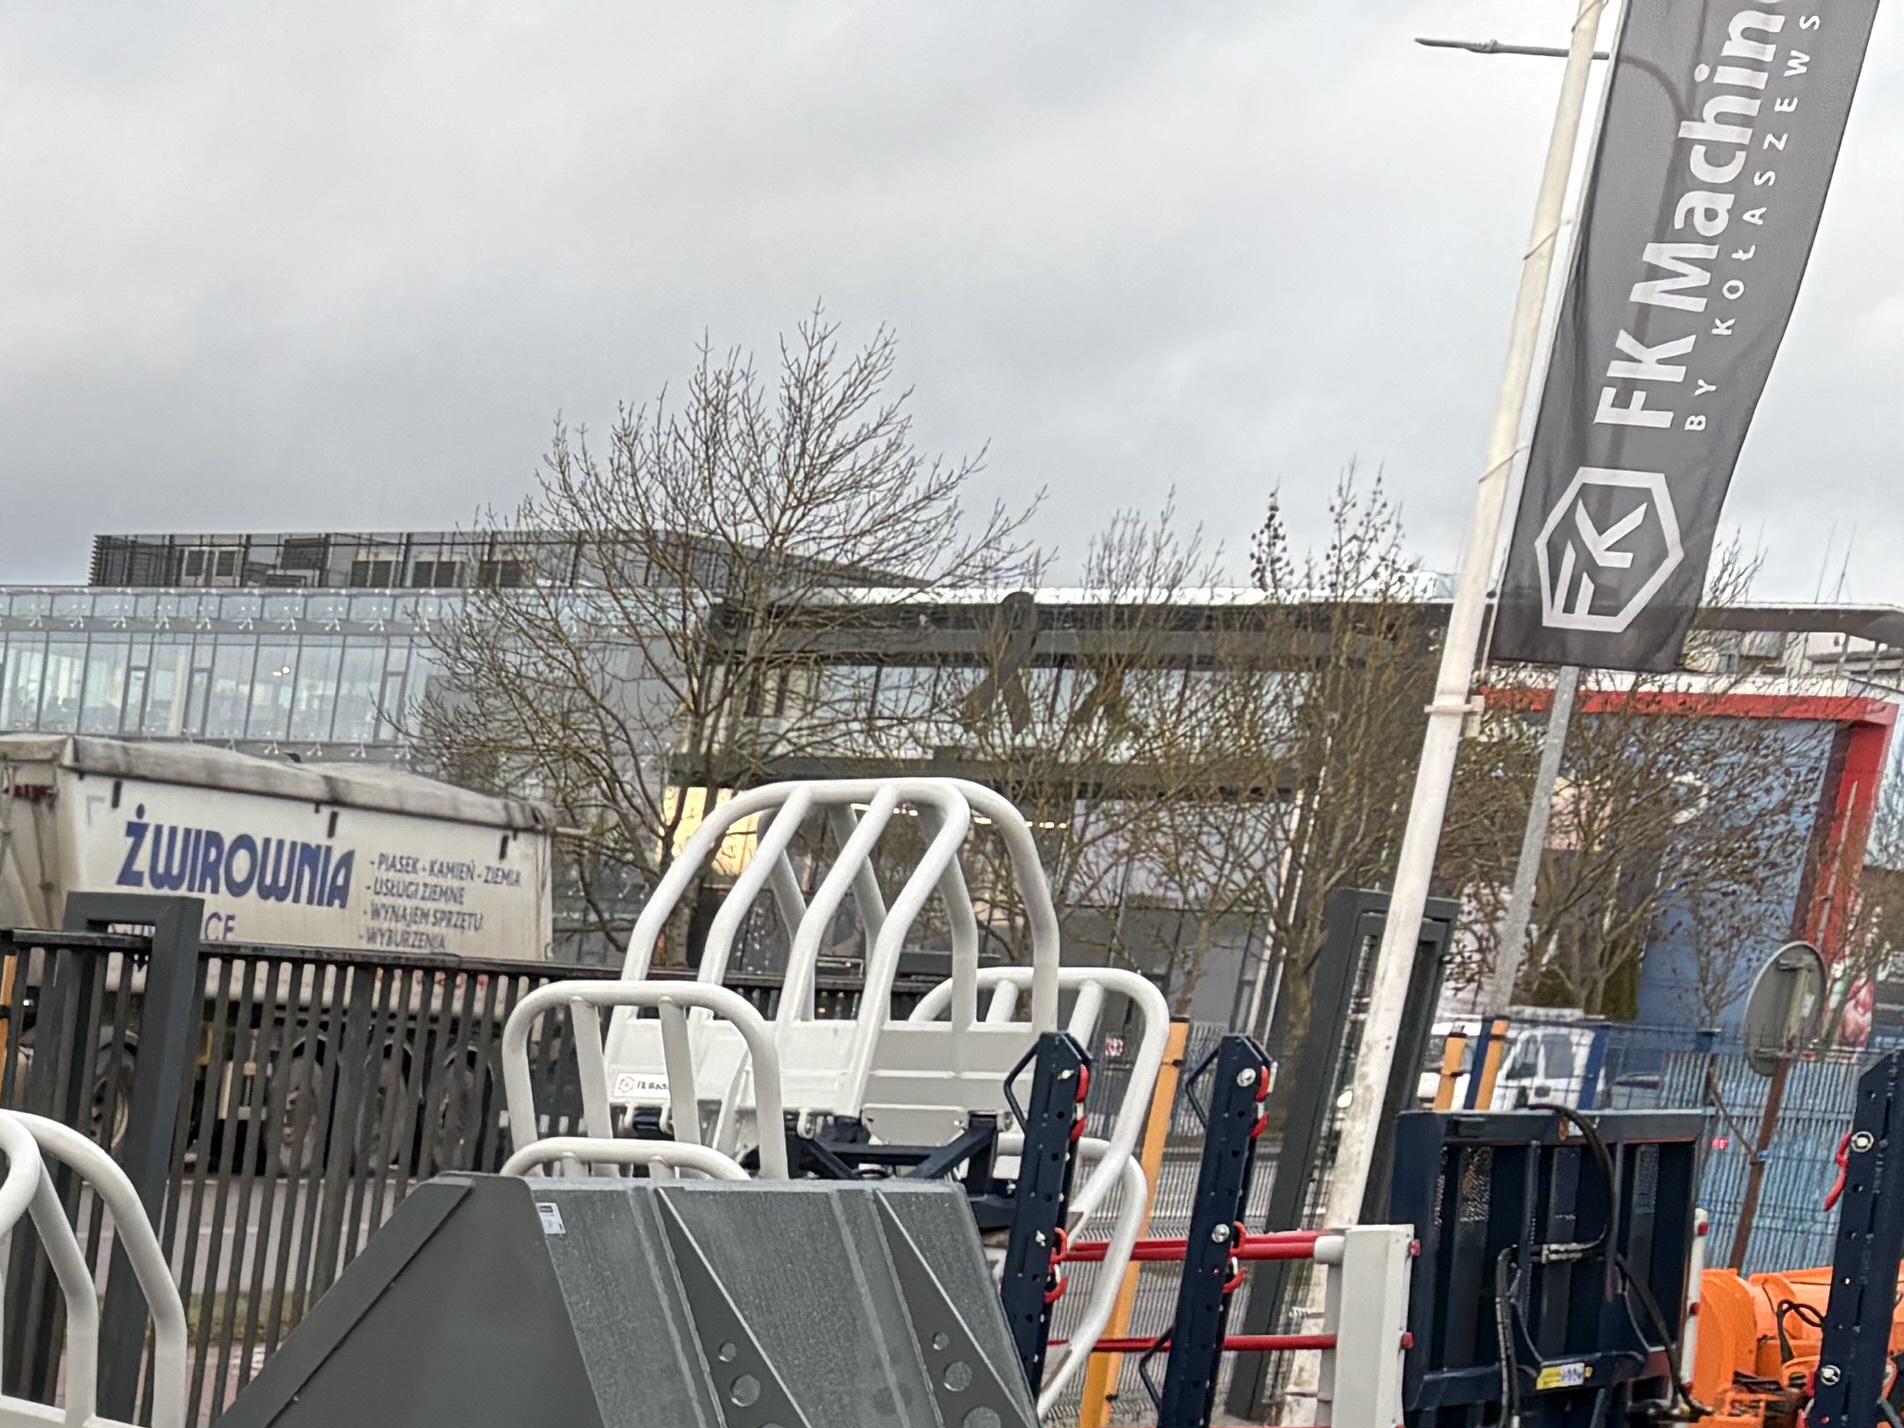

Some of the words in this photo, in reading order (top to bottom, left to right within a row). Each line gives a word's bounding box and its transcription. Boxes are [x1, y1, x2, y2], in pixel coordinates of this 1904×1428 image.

[1629, 0, 1786, 312] Machin
[1593, 328, 1696, 429] FK
[1684, 379, 1718, 431] BY
[116, 804, 355, 909] ŻWIROWNIA
